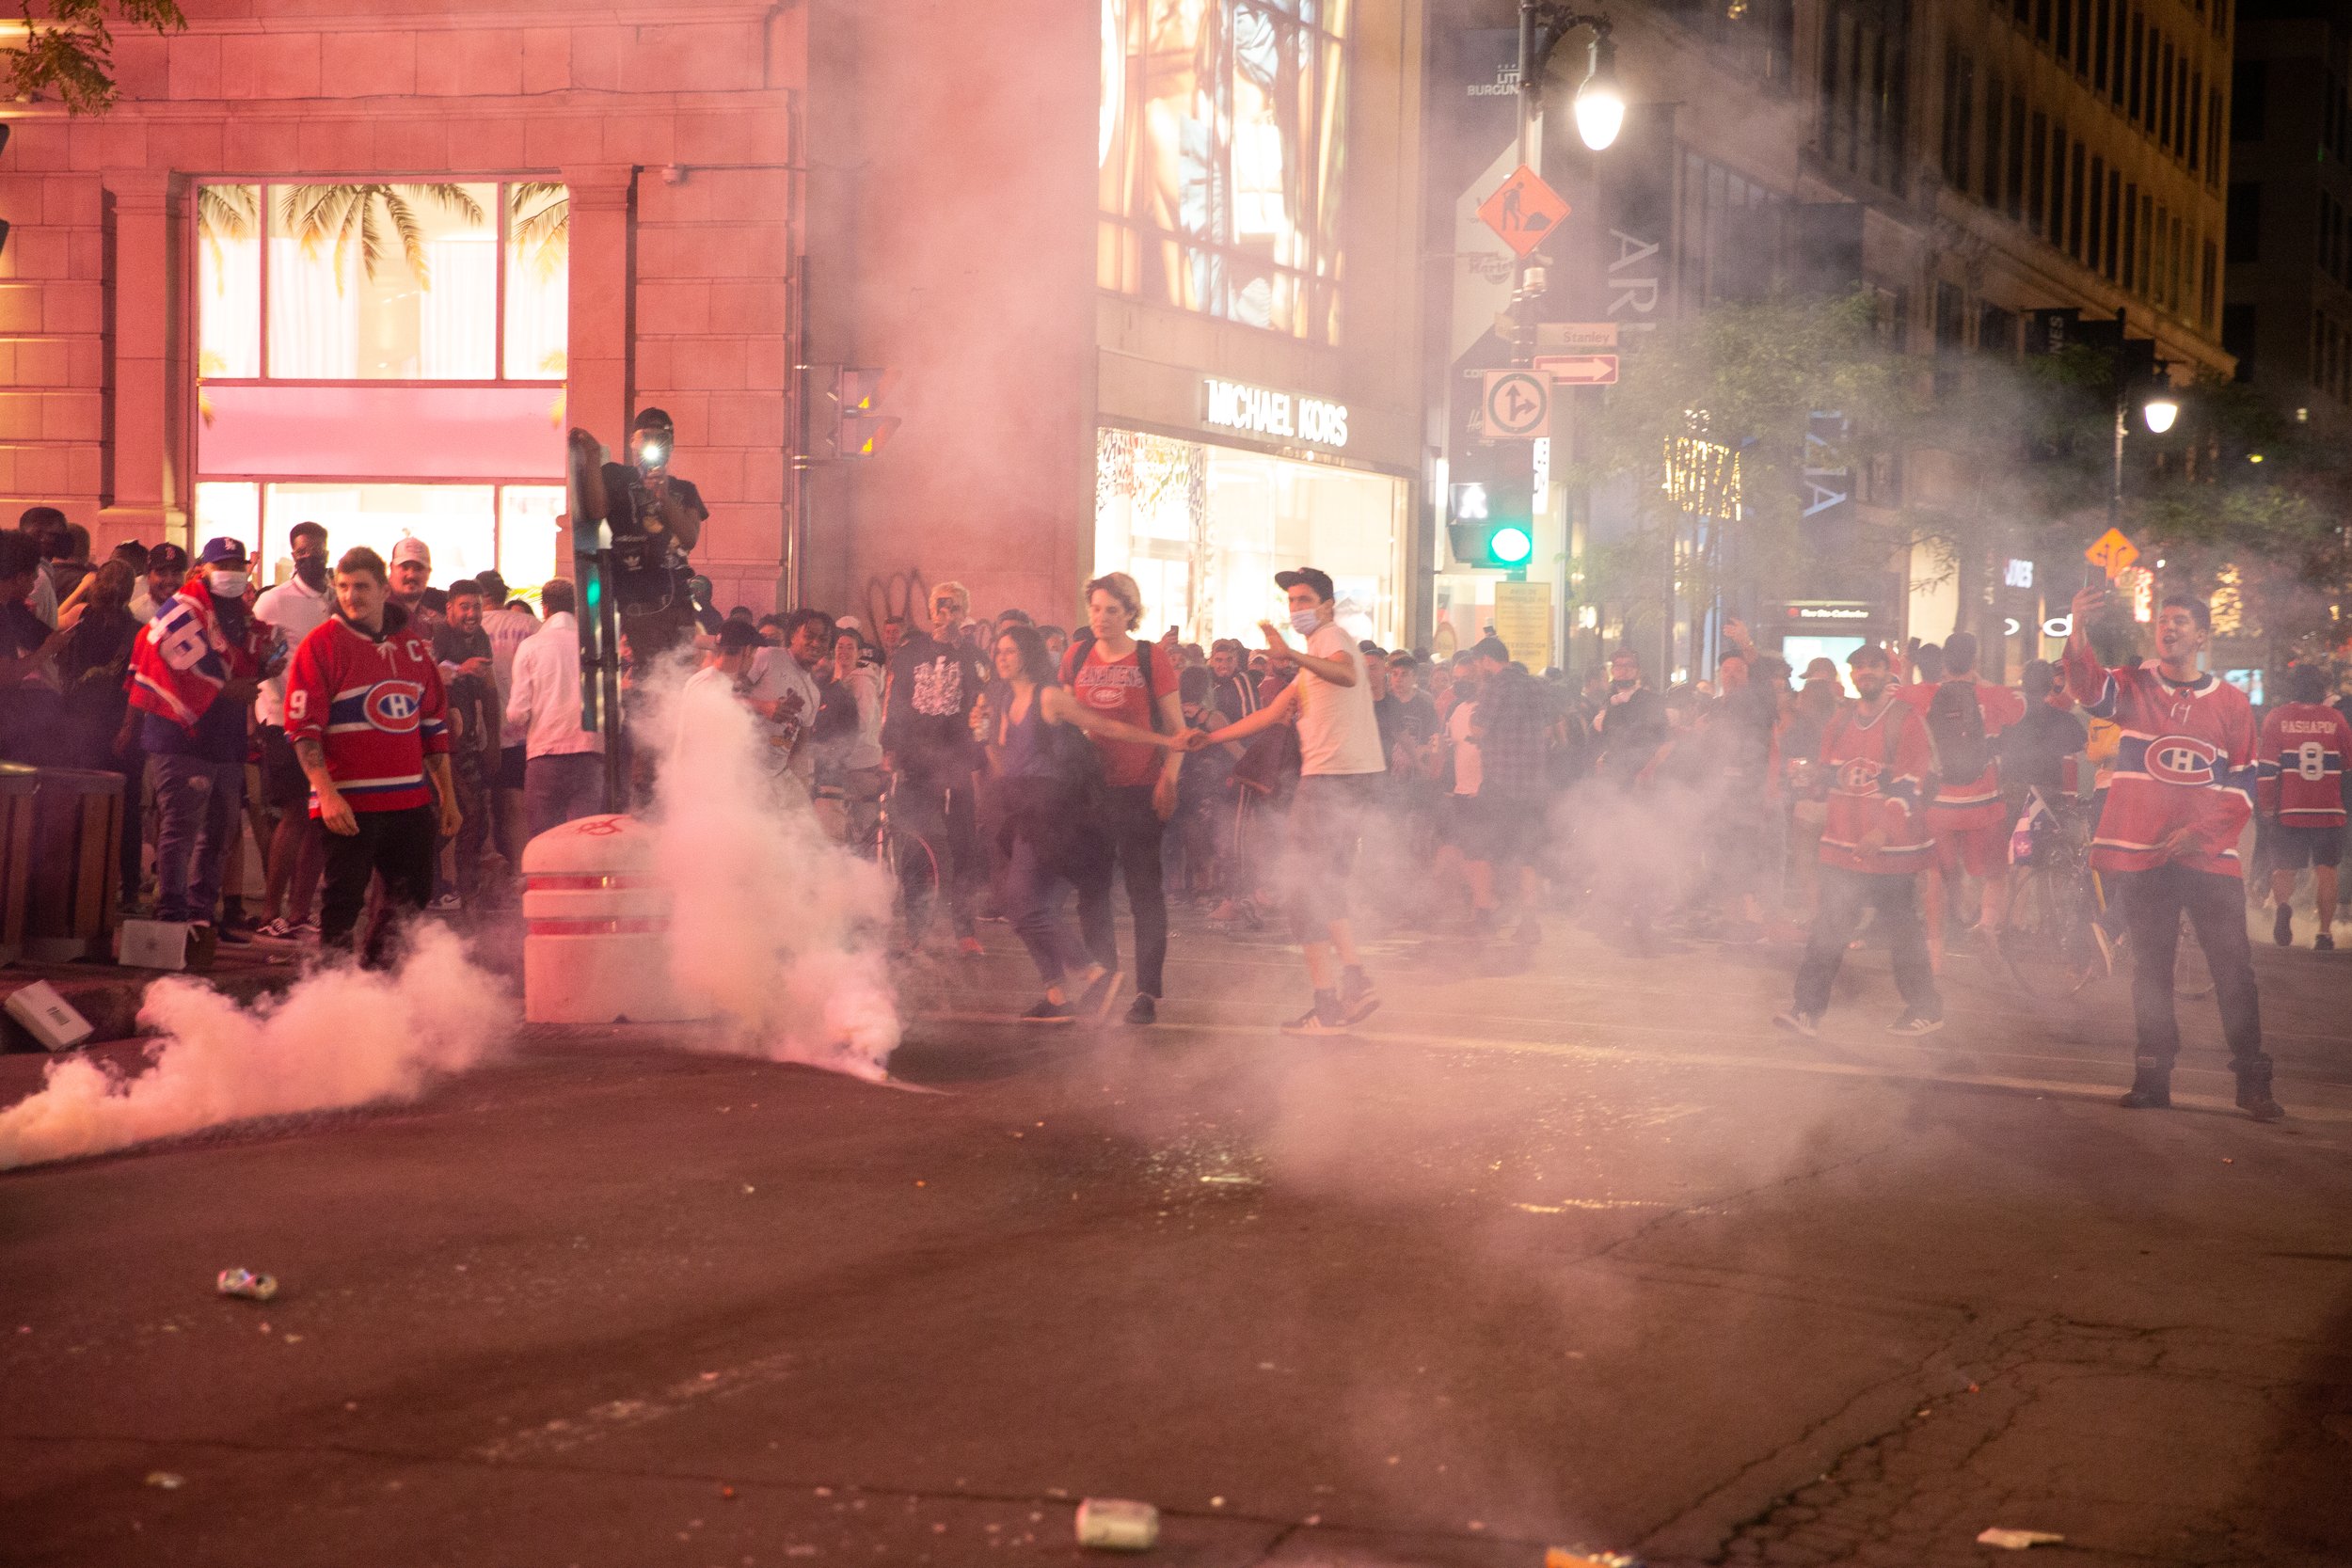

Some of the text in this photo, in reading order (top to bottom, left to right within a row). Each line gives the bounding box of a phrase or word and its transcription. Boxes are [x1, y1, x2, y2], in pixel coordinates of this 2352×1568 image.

[1468, 84, 1519, 95] BURGUN
[1563, 331, 1611, 346] Stanley
[1203, 379, 1348, 447] MICHAEL KORS
[406, 640, 423, 662] C
[290, 689, 308, 729] 9
[2299, 741, 2325, 782] 8
